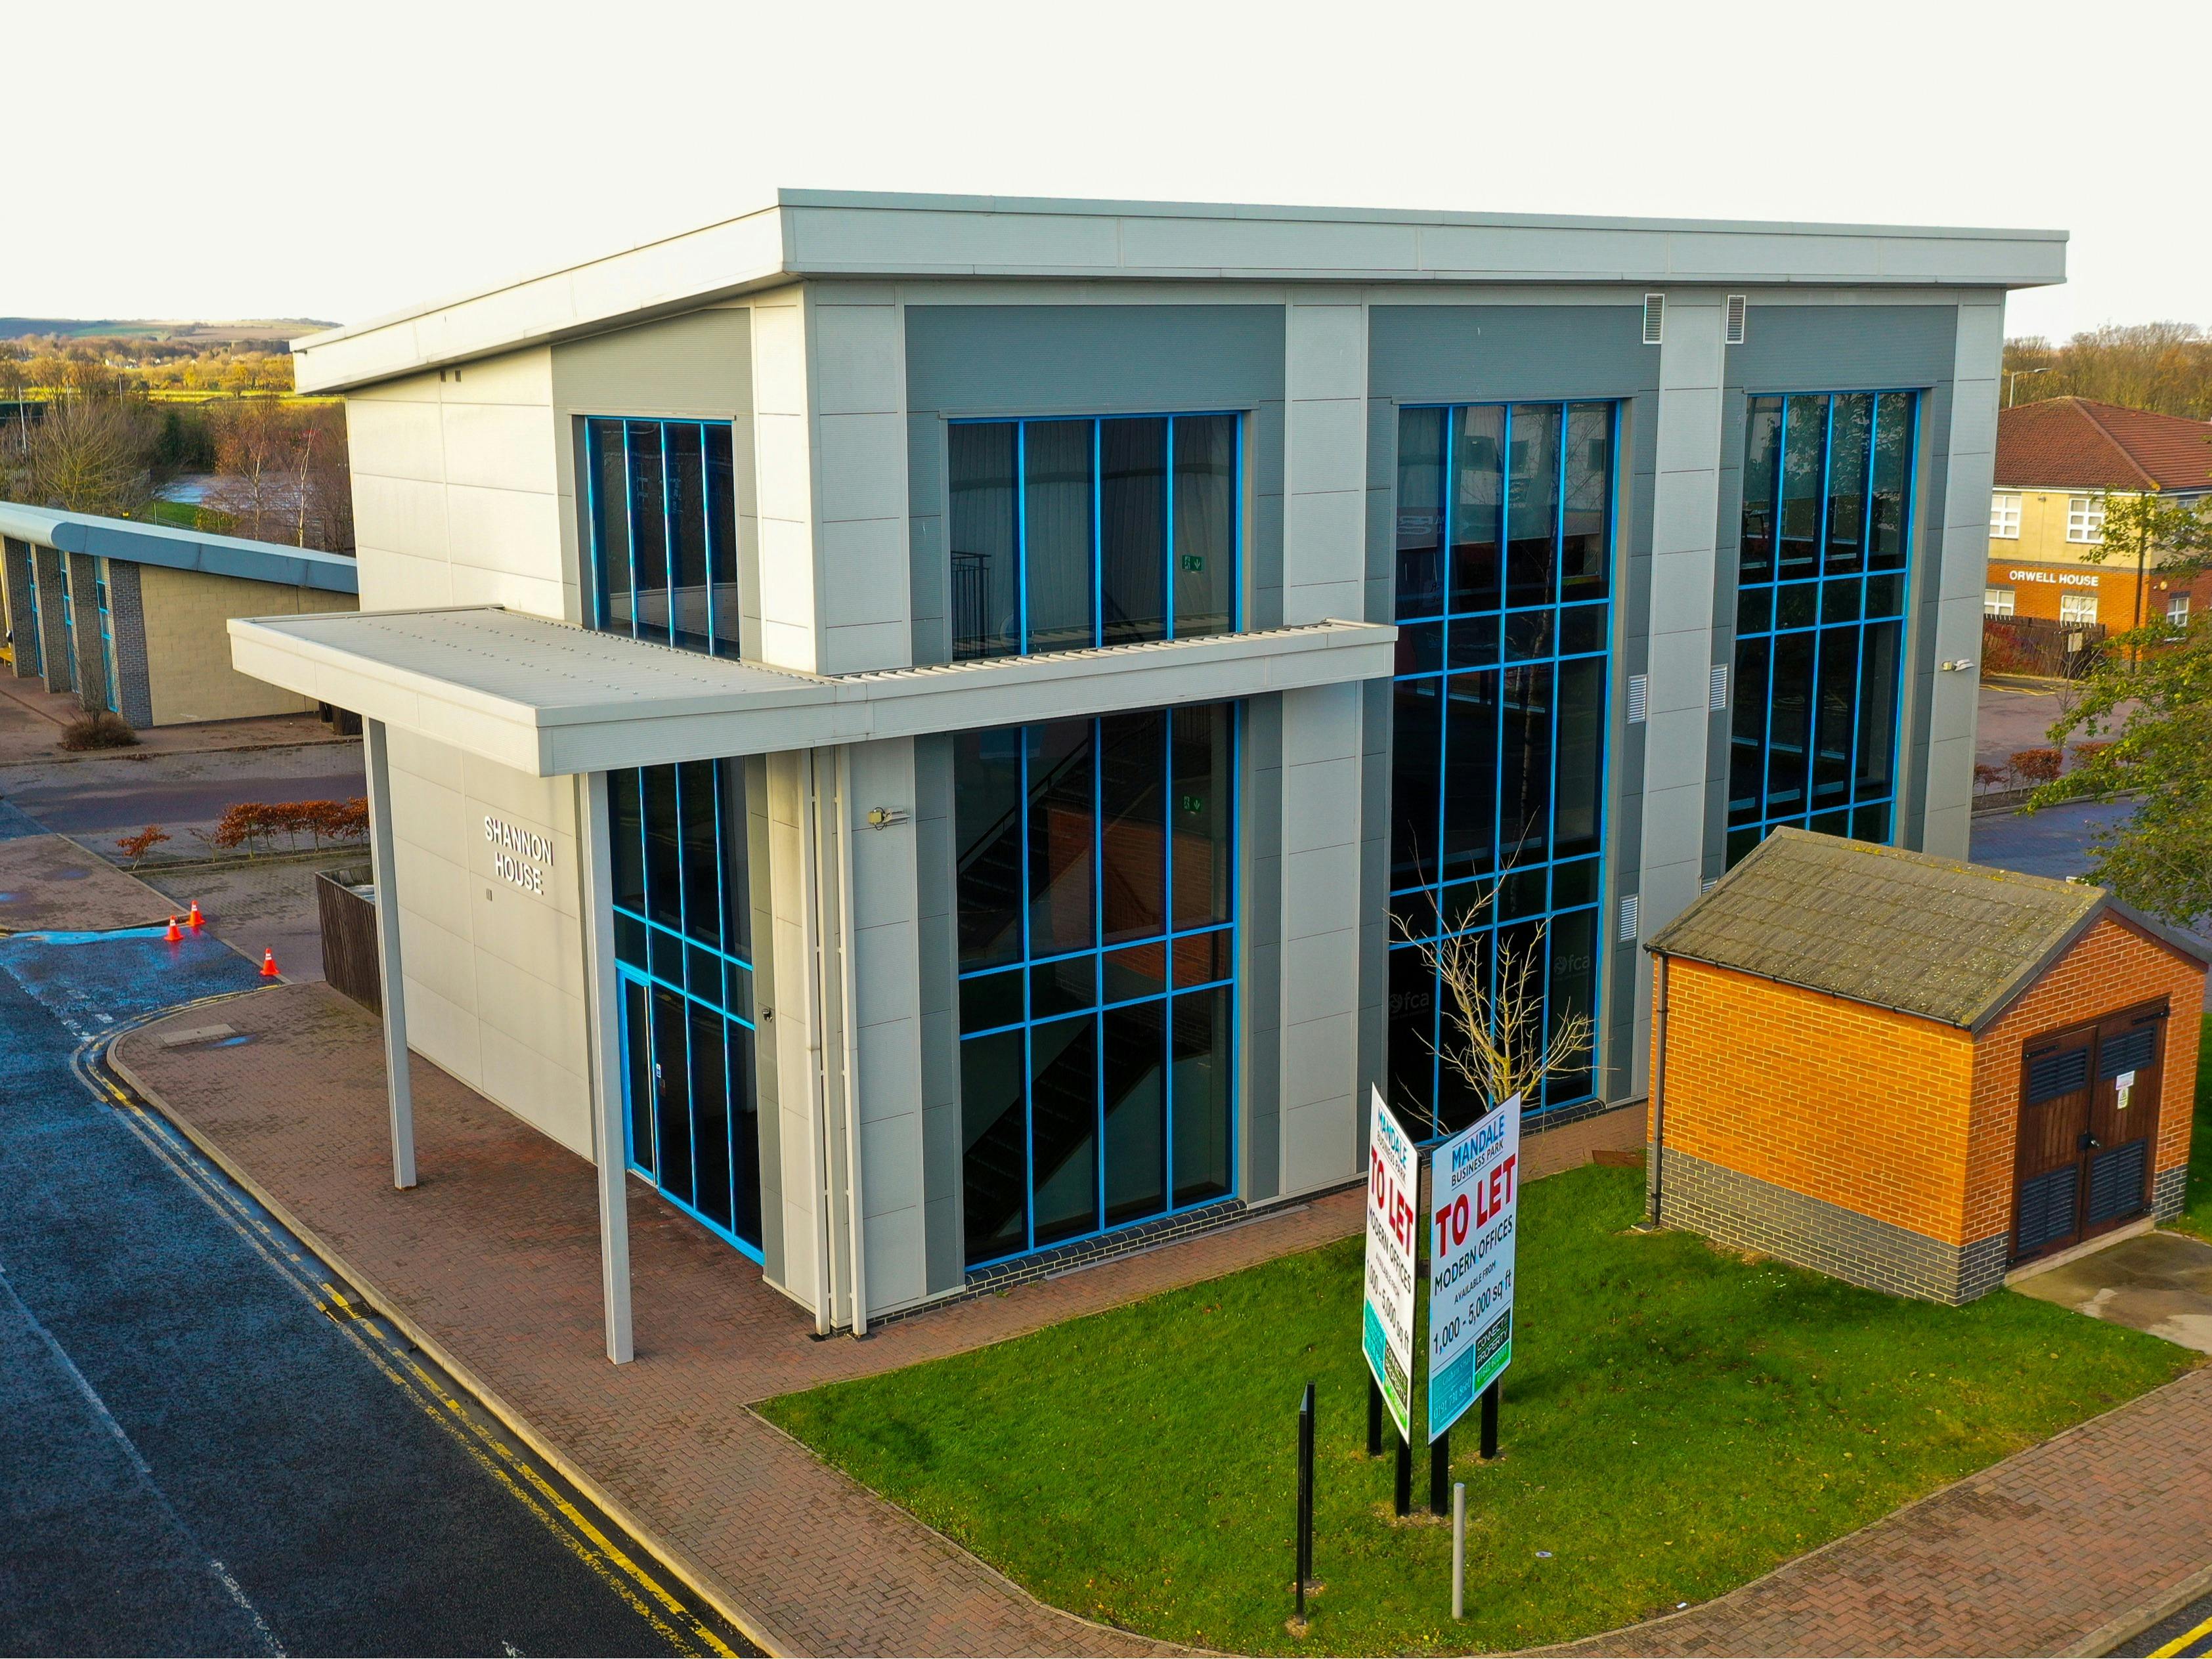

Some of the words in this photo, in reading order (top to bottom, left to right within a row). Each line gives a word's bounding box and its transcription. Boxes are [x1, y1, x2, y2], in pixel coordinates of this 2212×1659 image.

[2009, 571, 2056, 583] ORWELL
[2058, 574, 2099, 587] HOUSE
[484, 815, 553, 866] SHANNON
[495, 851, 544, 895] HOUSE
[1377, 1106, 1407, 1171] MANDALE
[1377, 1132, 1395, 1167] BUSINESS
[1395, 1160, 1406, 1184] PARK
[1451, 1152, 1485, 1185] BUSINESS
[1486, 1137, 1504, 1164] PARK
[1452, 1114, 1505, 1172] MANDALE
[1371, 1145, 1385, 1210] TO
[1389, 1174, 1413, 1258] LET
[1435, 1193, 1469, 1258] TO
[1477, 1153, 1516, 1229] LET
[1368, 1205, 1389, 1255] MODERN
[1389, 1243, 1411, 1295] OFFICES
[1435, 1251, 1476, 1297] MODERN
[1479, 1214, 1513, 1260] OFFICES
[1367, 1257, 1378, 1295] 1,000
[1381, 1289, 1396, 1328] 5,000
[1397, 1320, 1403, 1349] sq
[1404, 1329, 1409, 1354] ft
[1454, 1275, 1482, 1304] AVAILABLE
[1482, 1260, 1496, 1281] FROM
[1434, 1316, 1460, 1356] 1,000
[1468, 1293, 1491, 1326] 5,000
[1492, 1283, 1503, 1304] sq
[1505, 1268, 1511, 1290] ft
[1477, 1327, 1508, 1366] PROPERTY
[1434, 1400, 1447, 1419] 0191
[1449, 1390, 1458, 1406] 731
